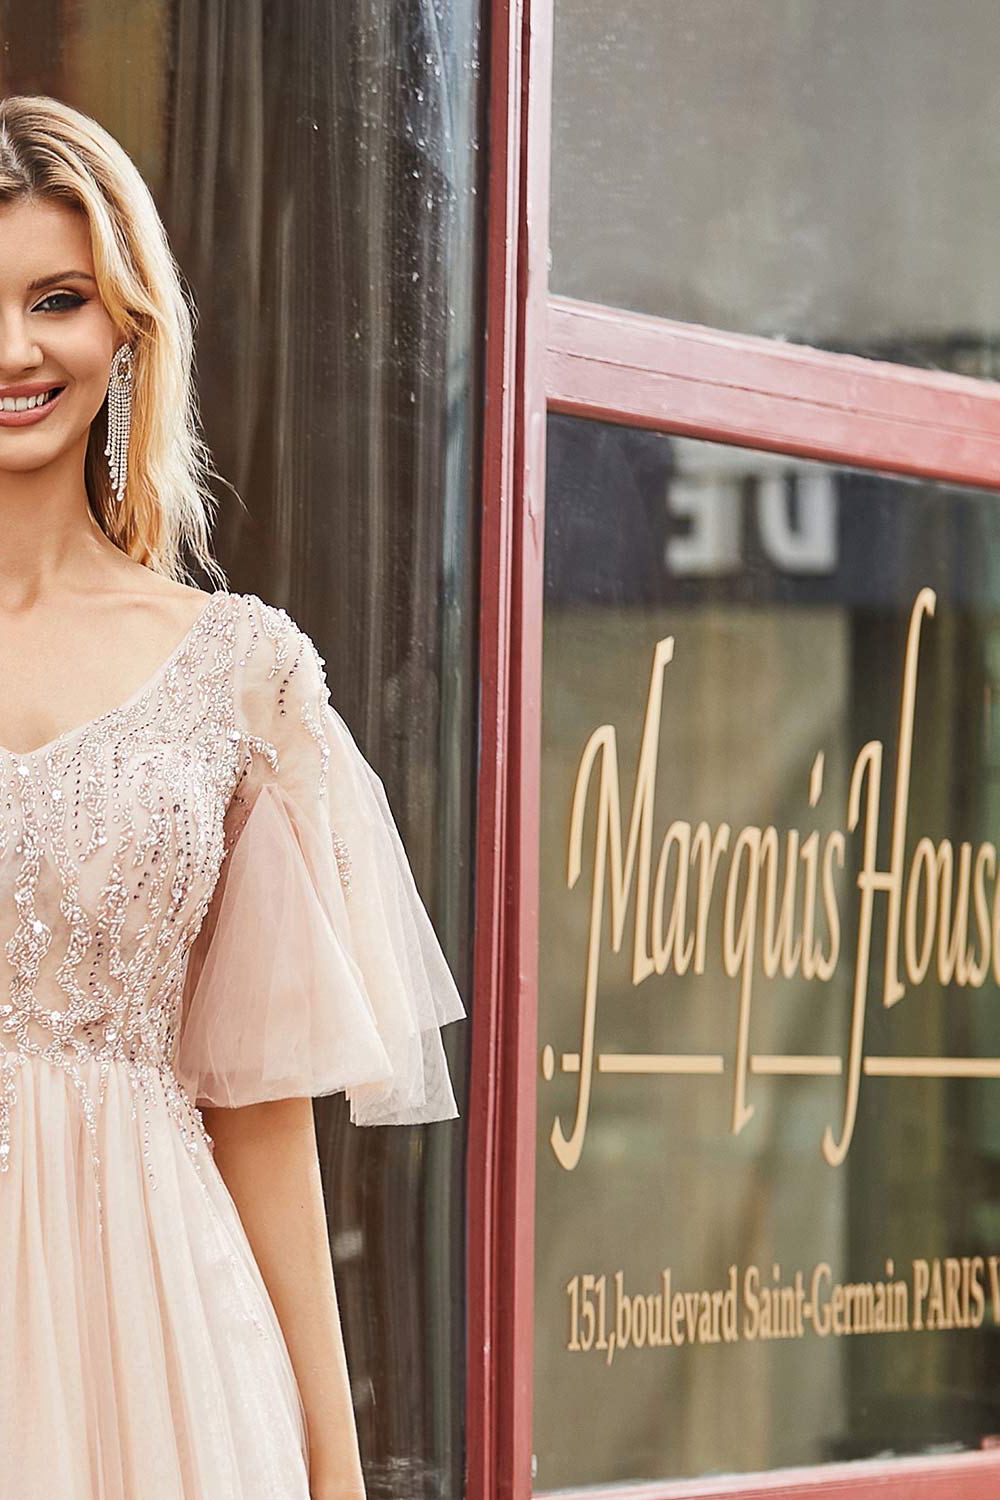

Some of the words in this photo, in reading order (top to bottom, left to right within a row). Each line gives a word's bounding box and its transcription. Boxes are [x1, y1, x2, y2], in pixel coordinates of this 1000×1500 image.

[551, 636, 845, 1171] Marquis
[743, 1258, 909, 1341] Saint-Germain
[911, 1255, 985, 1331] PARIS
